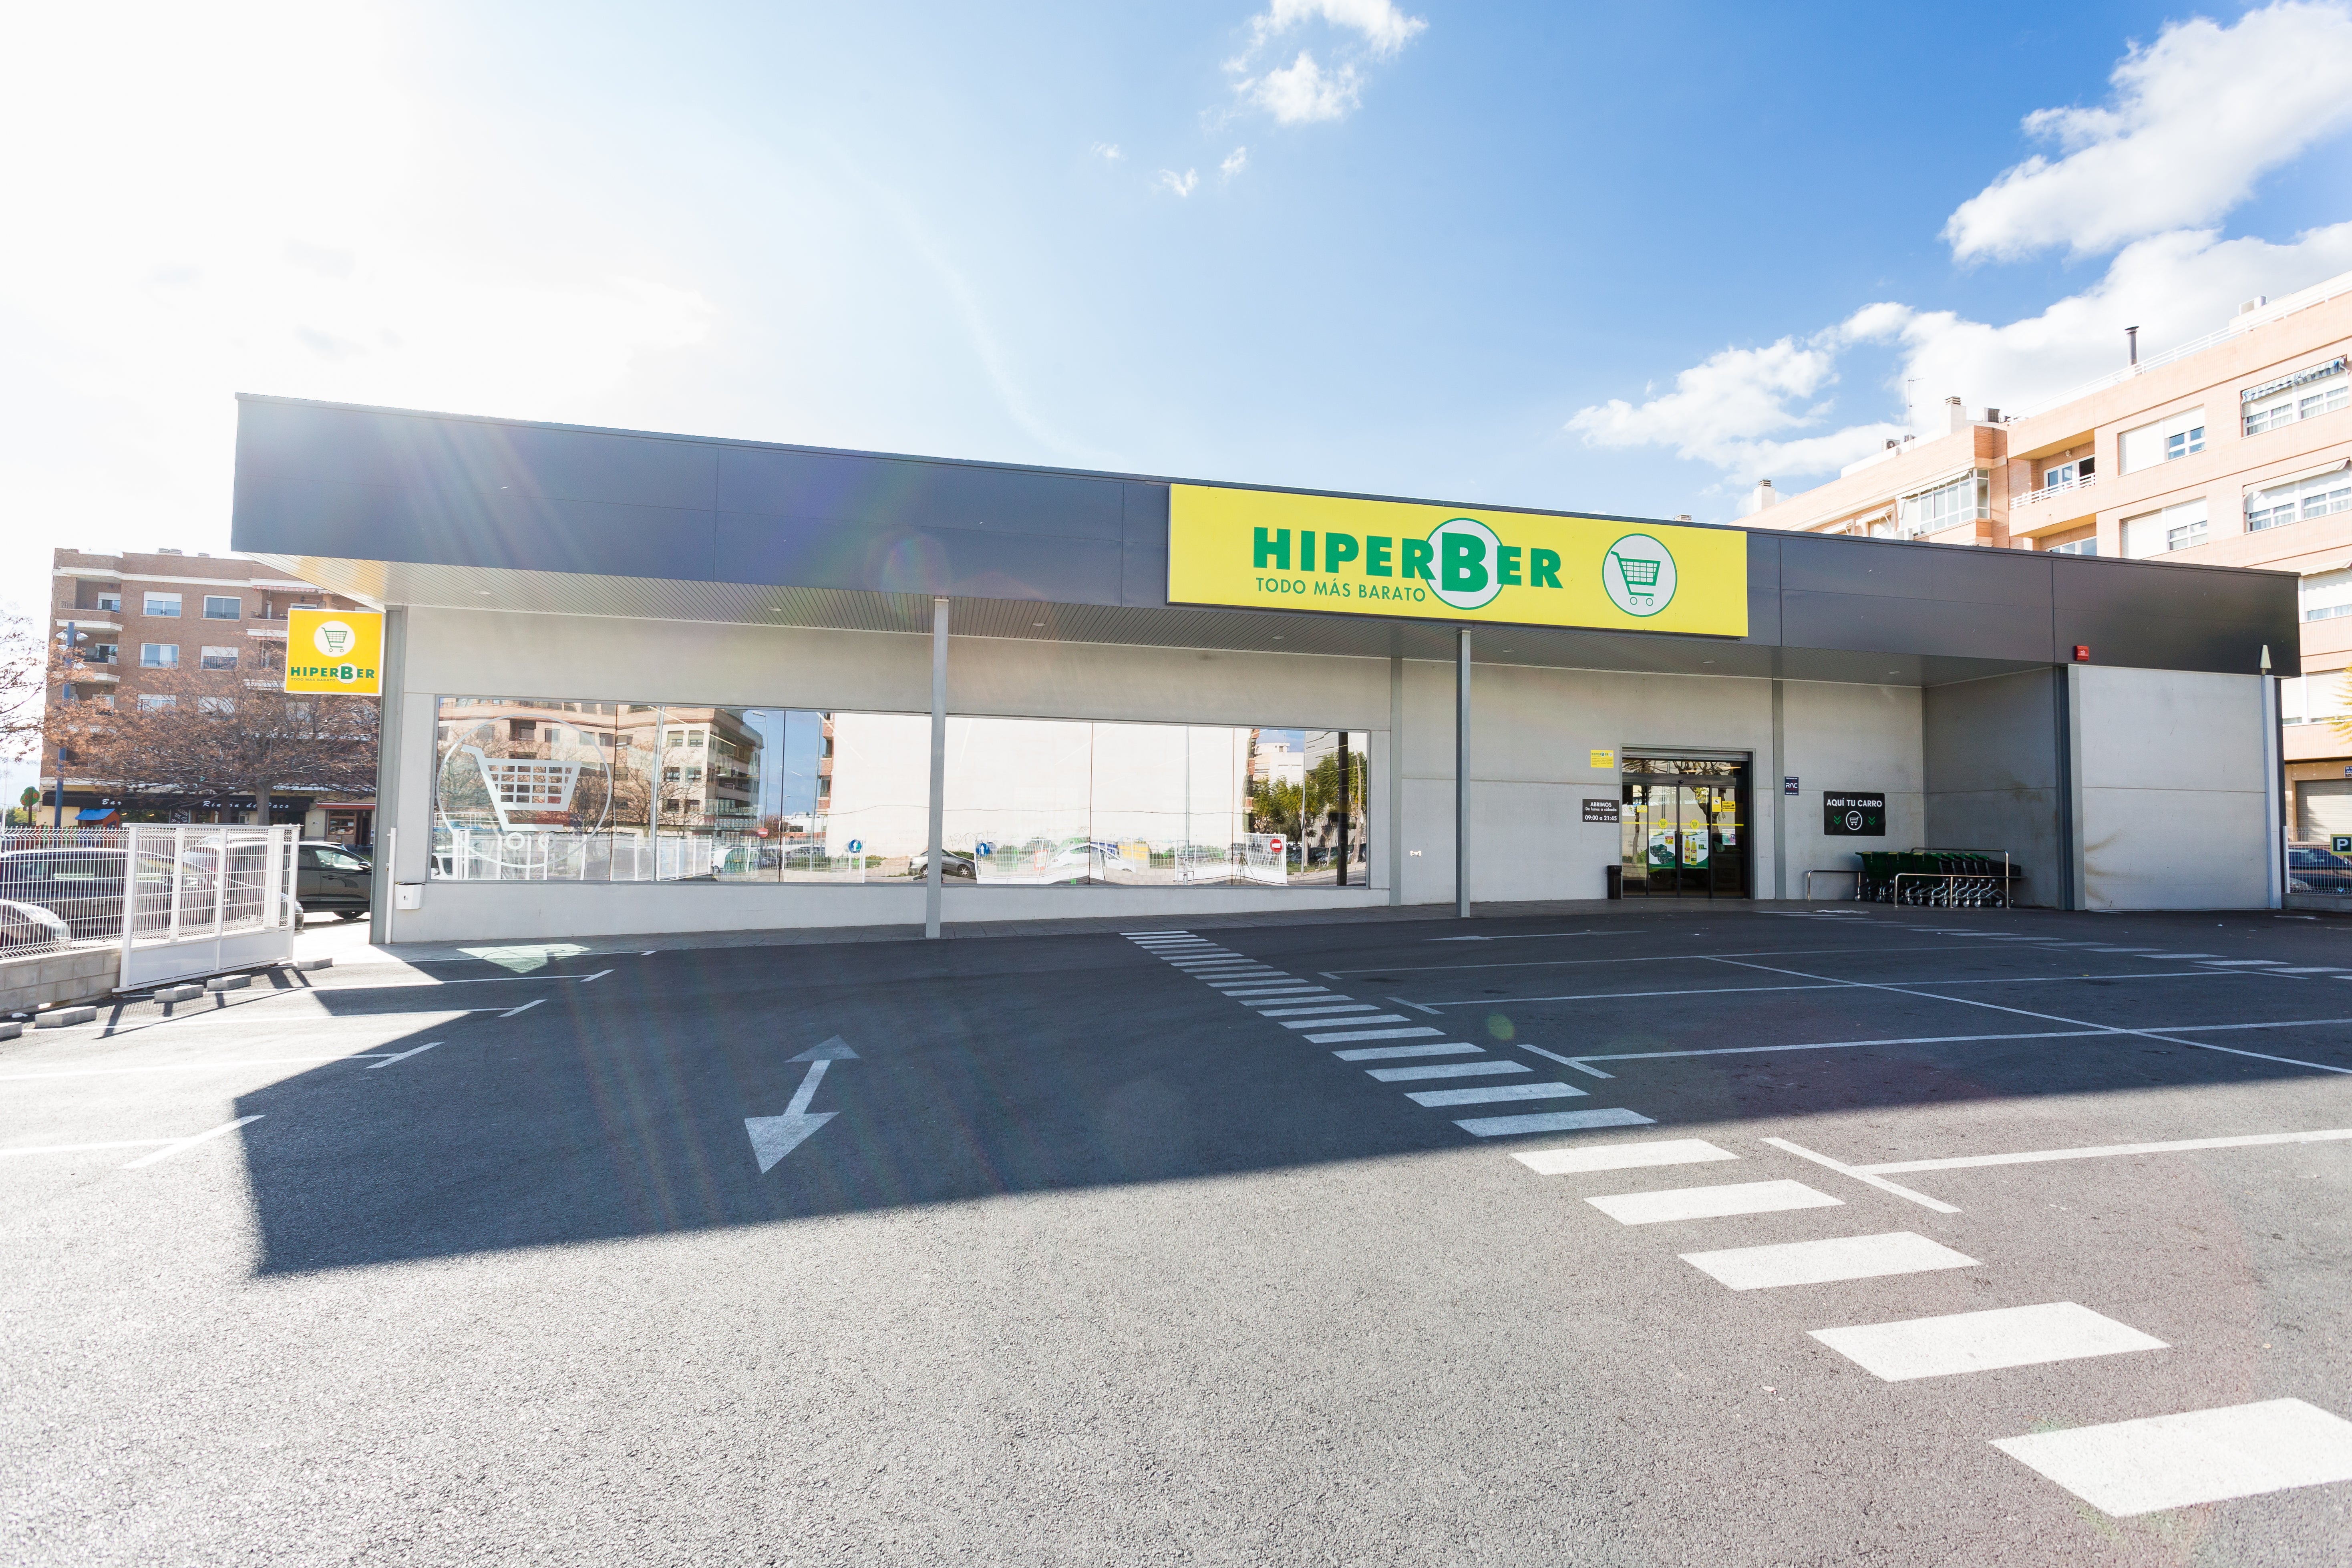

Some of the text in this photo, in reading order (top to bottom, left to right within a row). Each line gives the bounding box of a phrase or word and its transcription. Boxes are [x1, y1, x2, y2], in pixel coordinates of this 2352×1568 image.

[1253, 526, 1563, 592] HIPERBER
[1256, 577, 1426, 602] TODO MÁS BARATO
[290, 666, 375, 679] HIPERBER
[1827, 798, 1845, 807] AQUÍ
[2337, 838, 2348, 851] P
